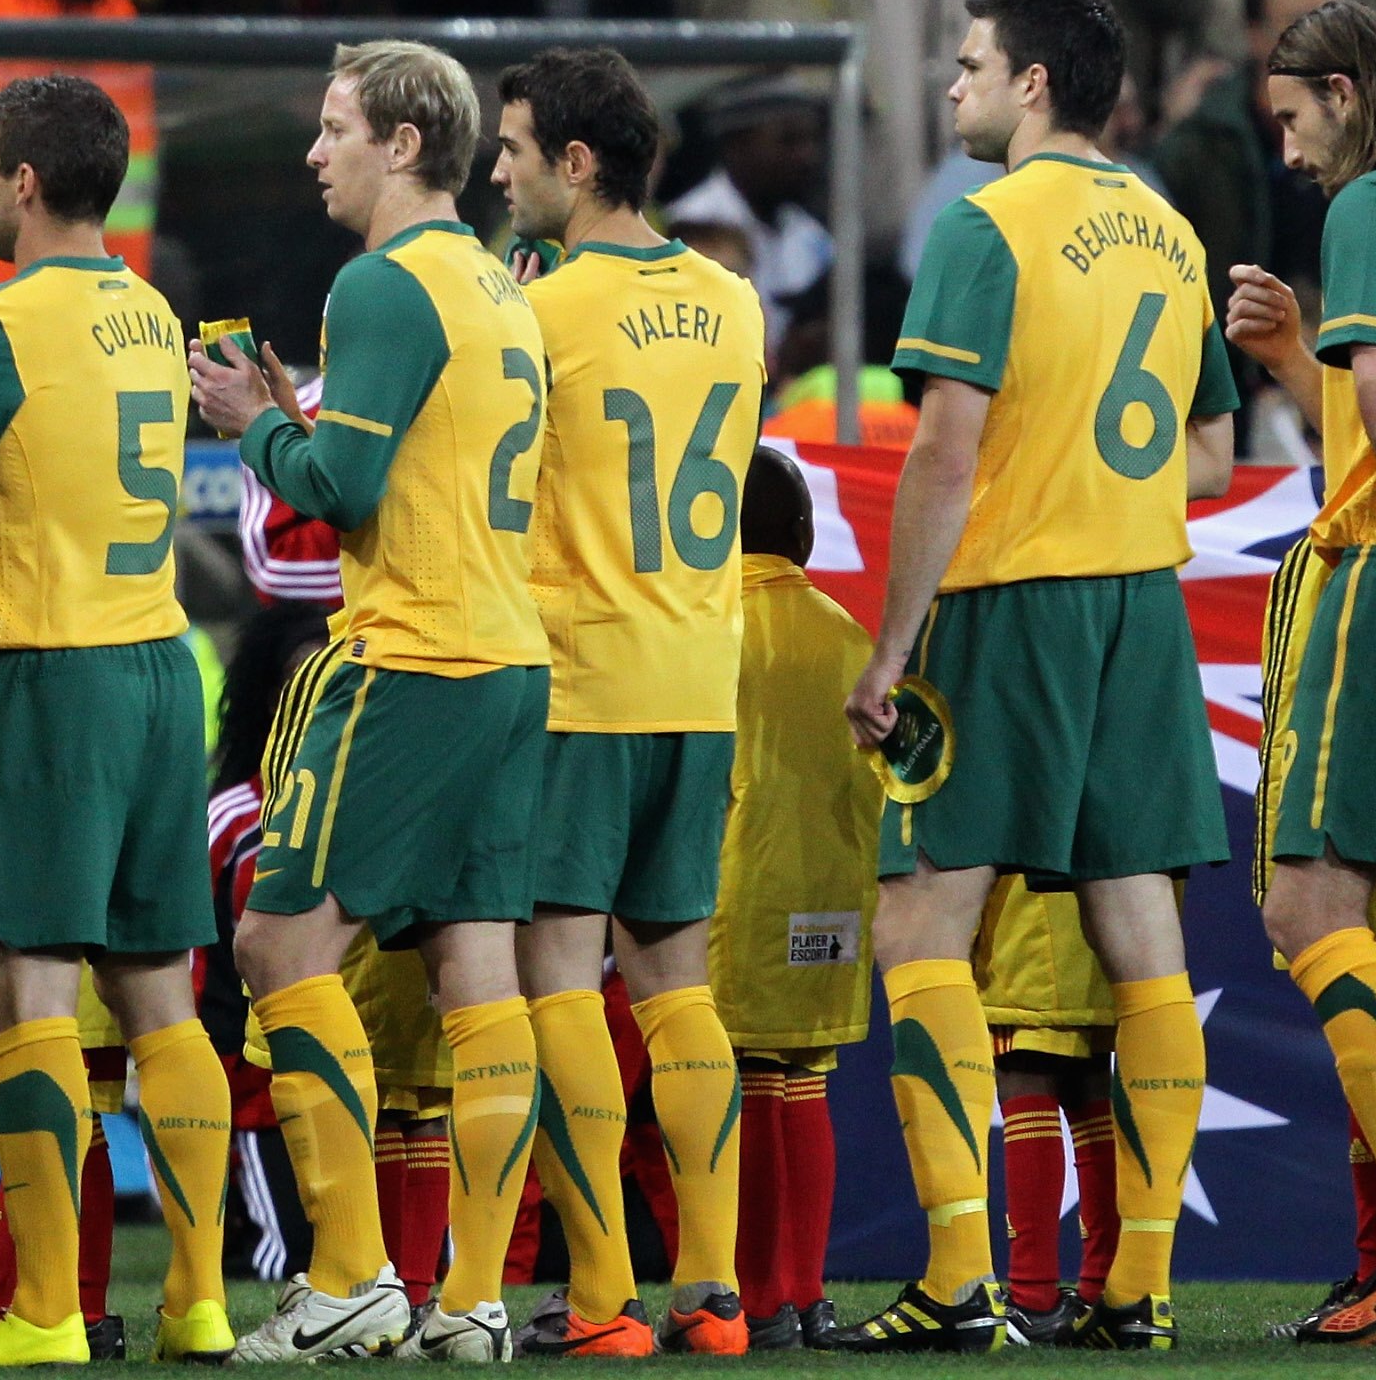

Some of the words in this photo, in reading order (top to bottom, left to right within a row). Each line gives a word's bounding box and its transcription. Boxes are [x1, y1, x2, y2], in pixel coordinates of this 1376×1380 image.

[1061, 211, 1197, 285] BEAUCHAMP
[92, 311, 176, 356] CULINA
[618, 303, 722, 351] VALERI
[1094, 291, 1178, 481] 6
[105, 390, 178, 575] 5
[182, 465, 241, 513] co
[603, 382, 742, 573] 16
[900, 722, 939, 779] AUSTRALIA
[790, 947, 828, 961] ESCORT
[791, 934, 828, 949] PLAYER
